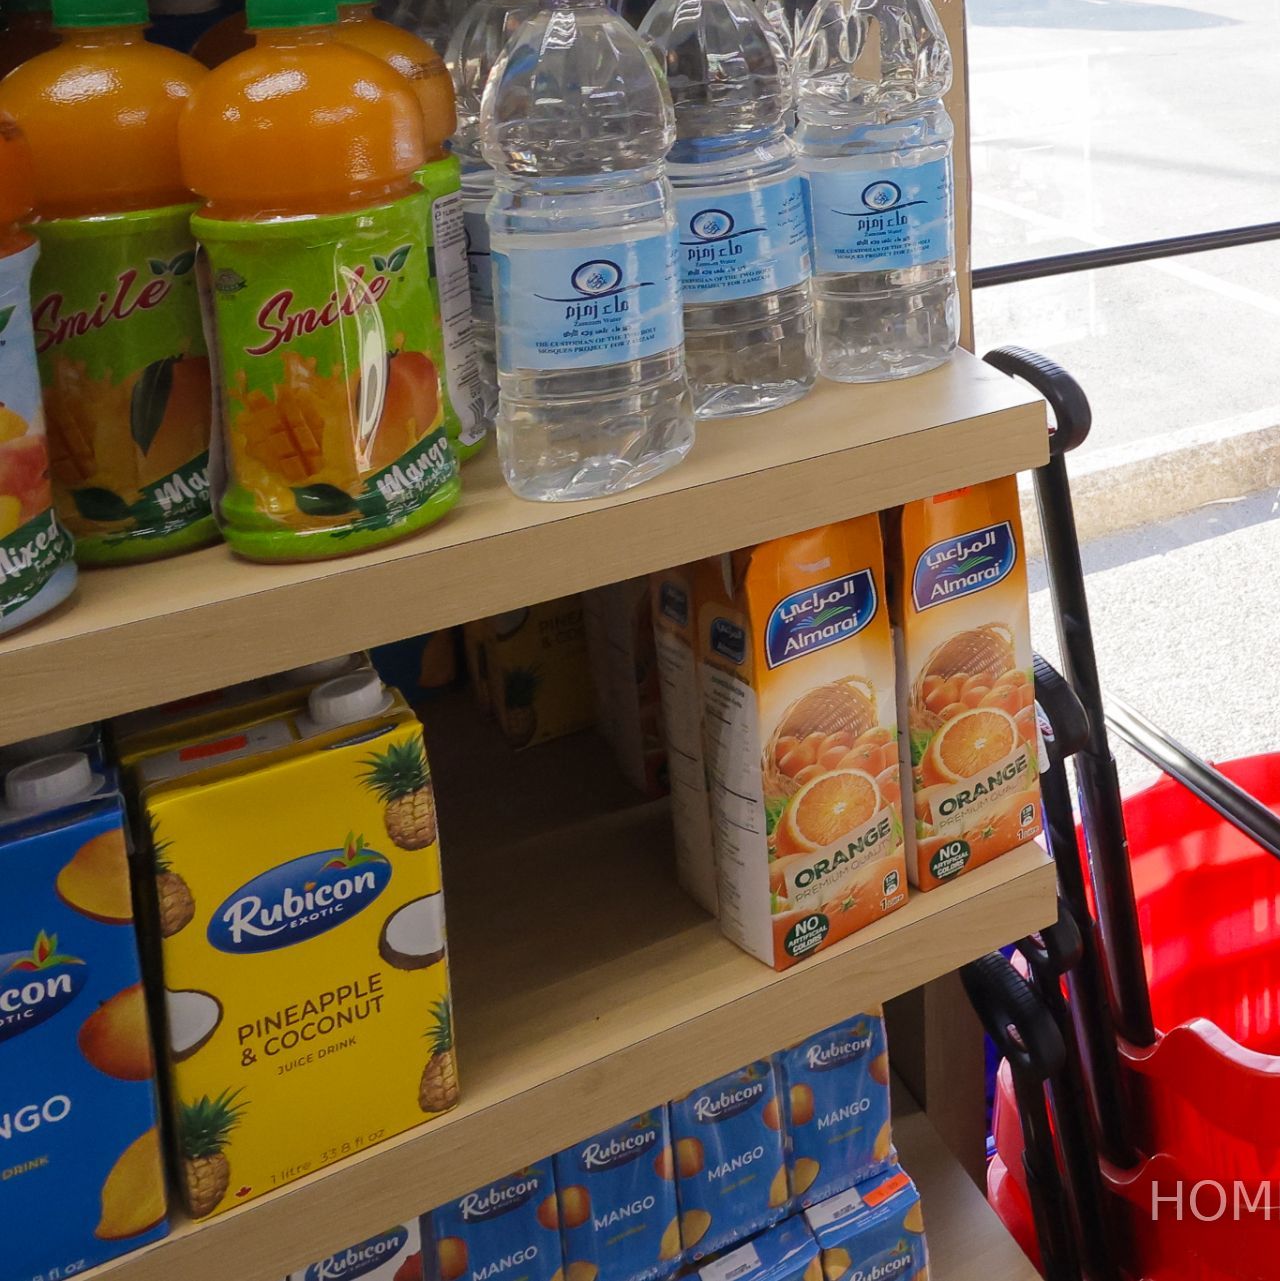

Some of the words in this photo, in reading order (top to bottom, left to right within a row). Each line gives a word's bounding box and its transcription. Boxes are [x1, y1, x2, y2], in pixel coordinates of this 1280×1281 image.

[857, 215, 885, 232] زمزم
[887, 210, 909, 226] ماء
[687, 244, 715, 261] زمزم
[721, 239, 743, 257] ماء
[33, 269, 174, 355] Smile
[245, 265, 392, 357] Smile
[565, 301, 599, 321] زمزم
[602, 295, 630, 315] ماء
[376, 437, 450, 502] Mango
[926, 531, 996, 570] المراعي
[930, 562, 1000, 600] Almarai
[779, 580, 855, 622] المراعي
[784, 616, 859, 656] Almarai
[939, 754, 1028, 817] ORANGE
[794, 817, 892, 889] ORANGE
[932, 850, 969, 872] ARTIFICIAL
[936, 860, 965, 877] COLORS
[939, 842, 962, 858] NO
[795, 864, 850, 903] PREMIUM
[222, 870, 376, 944] Rubicon
[289, 903, 344, 929] EXOTIC
[795, 916, 820, 932] NO
[788, 924, 828, 948] ARTIFICIAL
[792, 934, 823, 954] COLORS
[237, 972, 384, 1046] PINEAPPLE
[240, 1047, 258, 1068] &
[263, 994, 386, 1058] COCONUT
[277, 1053, 314, 1076] JUICE
[317, 1035, 357, 1060] DRINK
[806, 1033, 875, 1069] Rubicon
[694, 1081, 763, 1122] Rubicon
[816, 1097, 871, 1131] MANGO
[368, 1127, 386, 1143] oz
[582, 1128, 656, 1169] Rubicon
[1, 1156, 50, 1181] DRINK
[706, 1145, 764, 1183] MANGO
[458, 1178, 538, 1220] Rubicon
[593, 1194, 655, 1232] MANGO
[313, 1233, 399, 1280] Rubicon
[472, 1244, 539, 1281] MANGO
